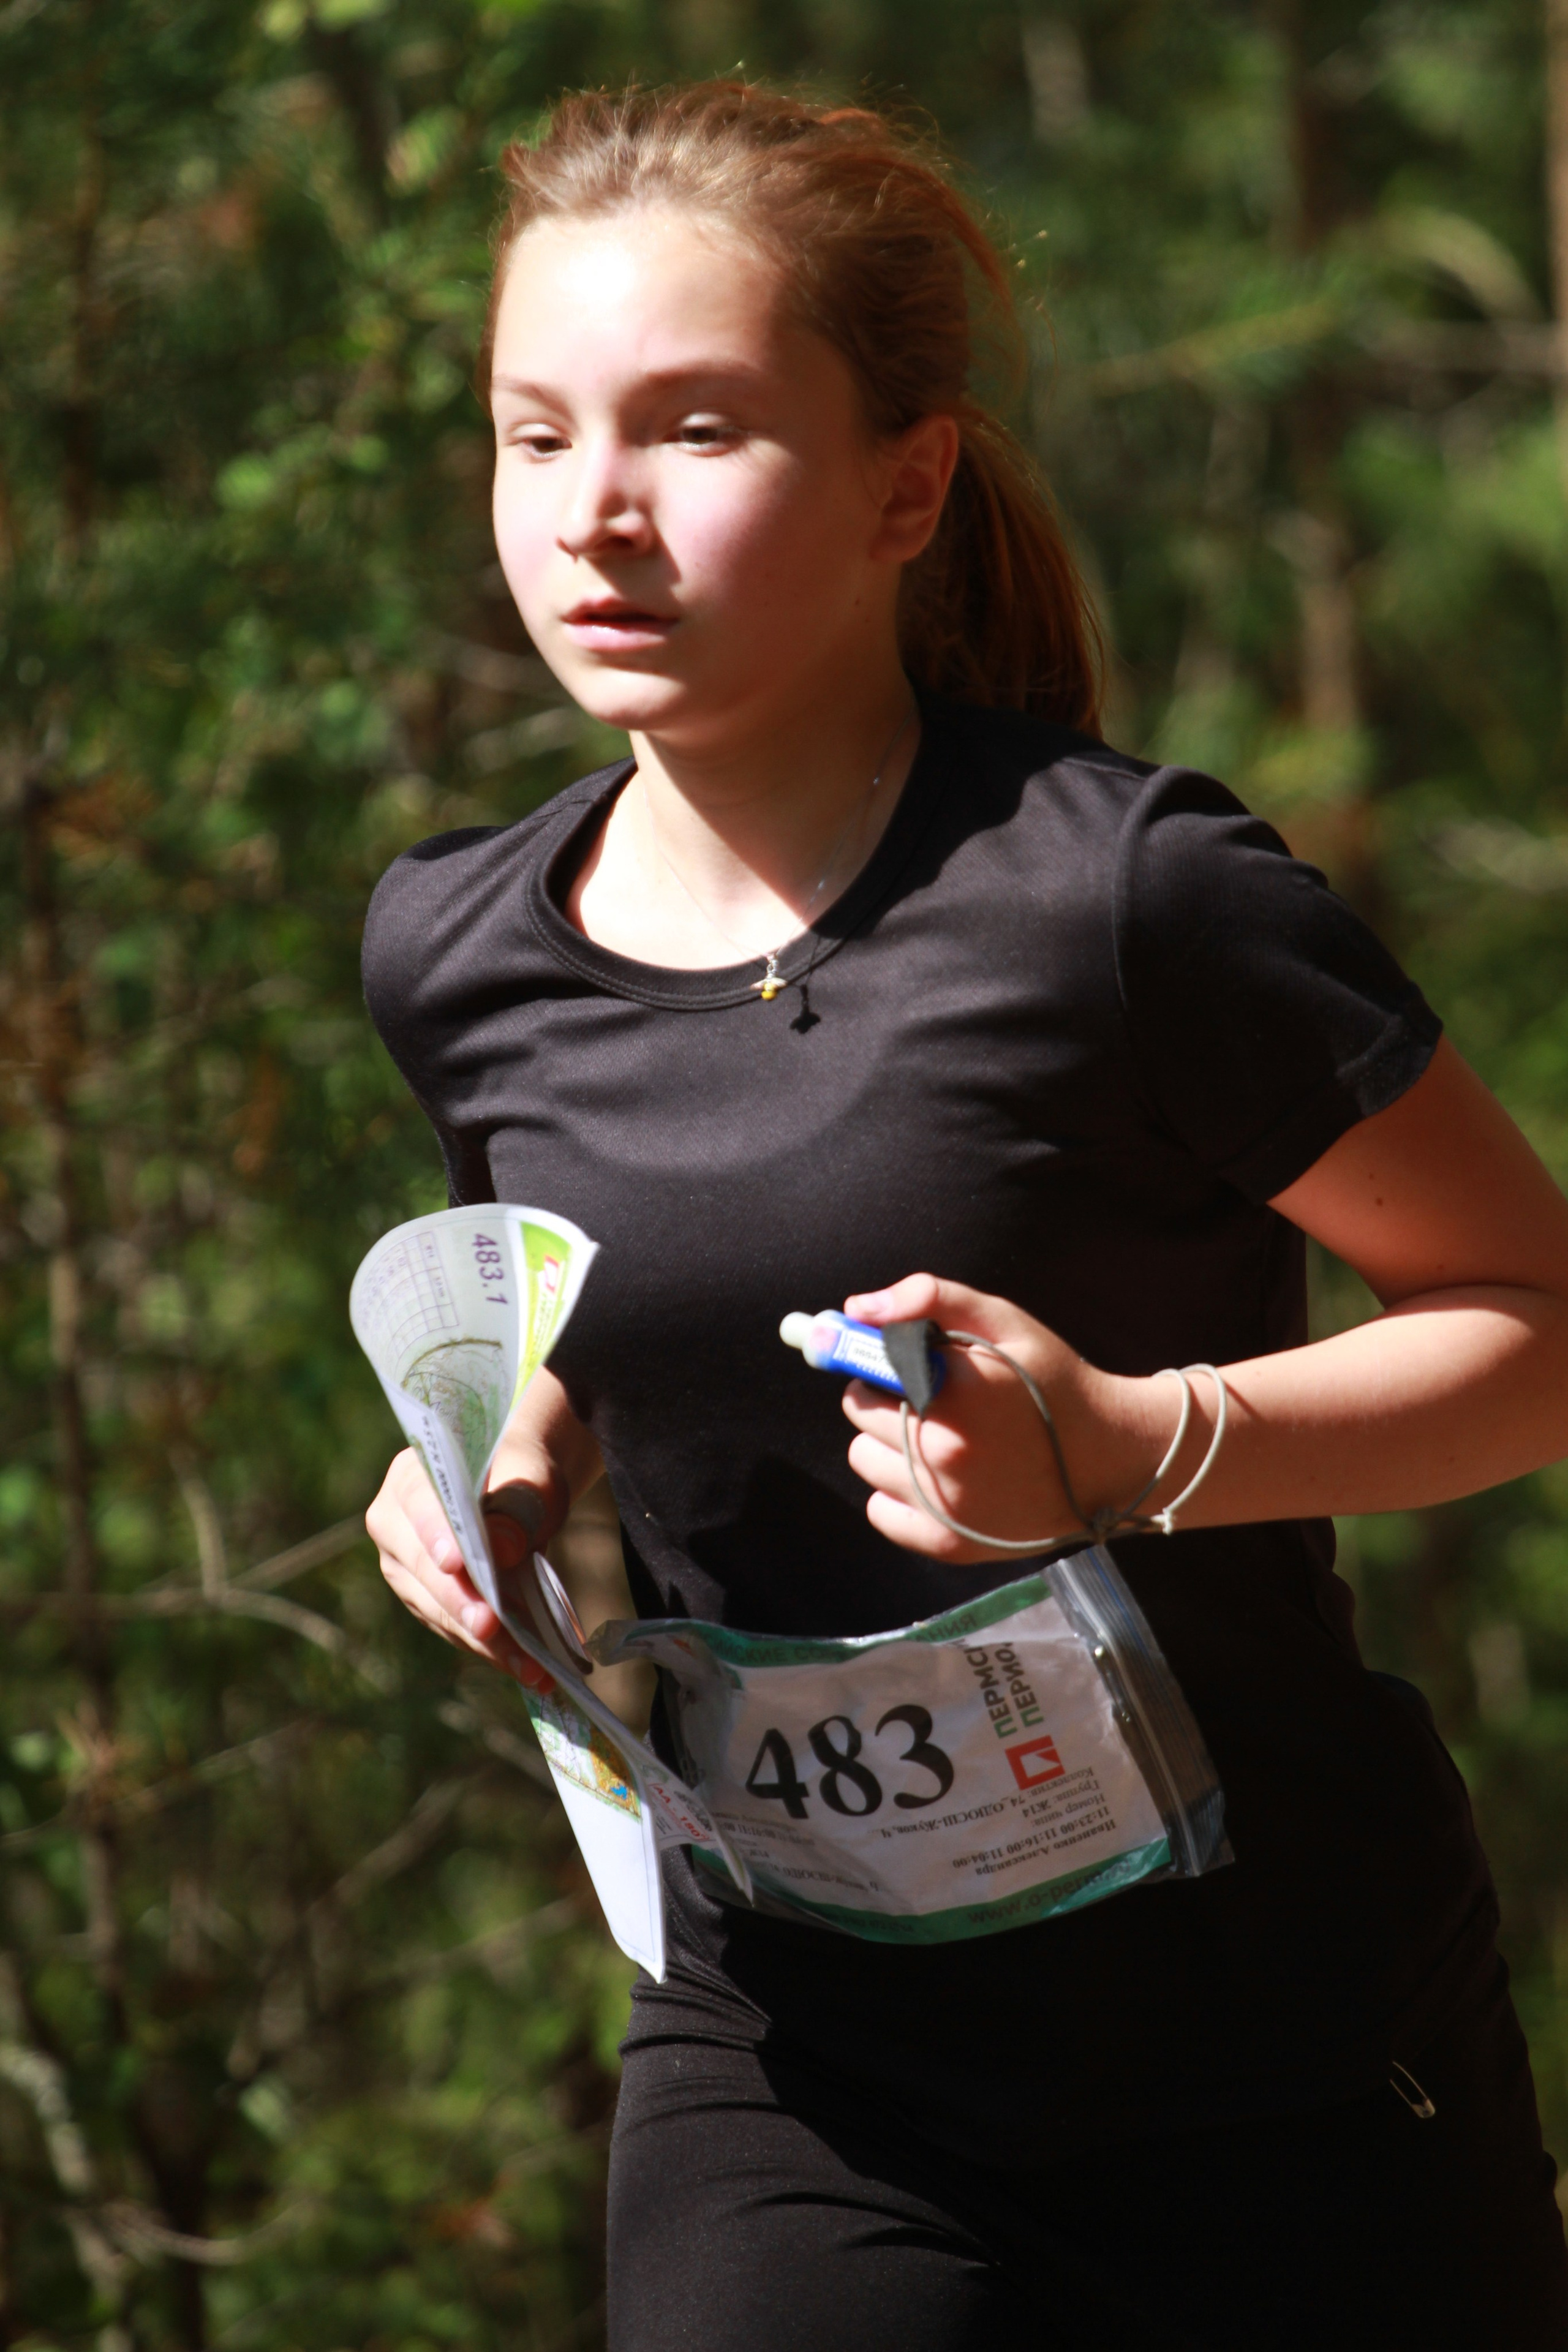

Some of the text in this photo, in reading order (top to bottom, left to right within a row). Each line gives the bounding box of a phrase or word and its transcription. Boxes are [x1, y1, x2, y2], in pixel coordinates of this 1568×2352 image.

[471, 1232, 508, 1305] 483.1
[994, 1642, 1044, 1728] ПЕРИО
[745, 1703, 955, 1820] 483
[1021, 1779, 1100, 1818] Группа: Ж14
[1065, 1792, 1106, 1814] Номер
[952, 1806, 1110, 1869] 11:23:00 11:16:00 11:04:00
